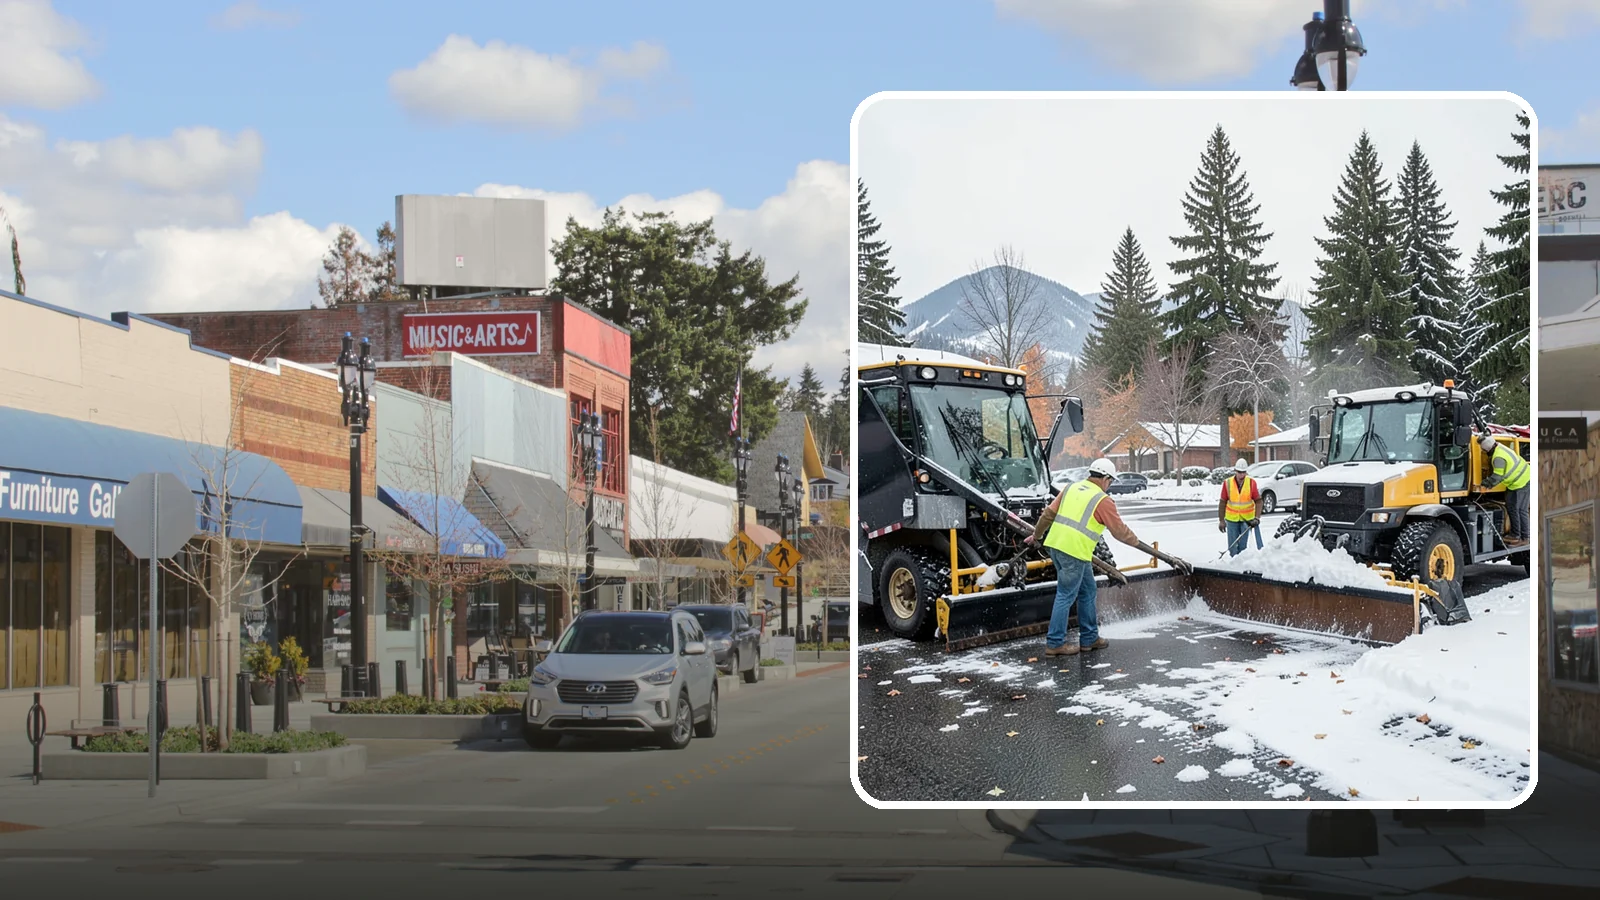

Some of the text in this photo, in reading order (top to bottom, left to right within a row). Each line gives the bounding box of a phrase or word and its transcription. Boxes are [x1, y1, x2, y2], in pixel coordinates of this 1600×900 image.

[409, 323, 520, 349] MUSIC&ARTS
[1540, 427, 1577, 437] UGA
[0, 471, 122, 519] Furniture Gal
